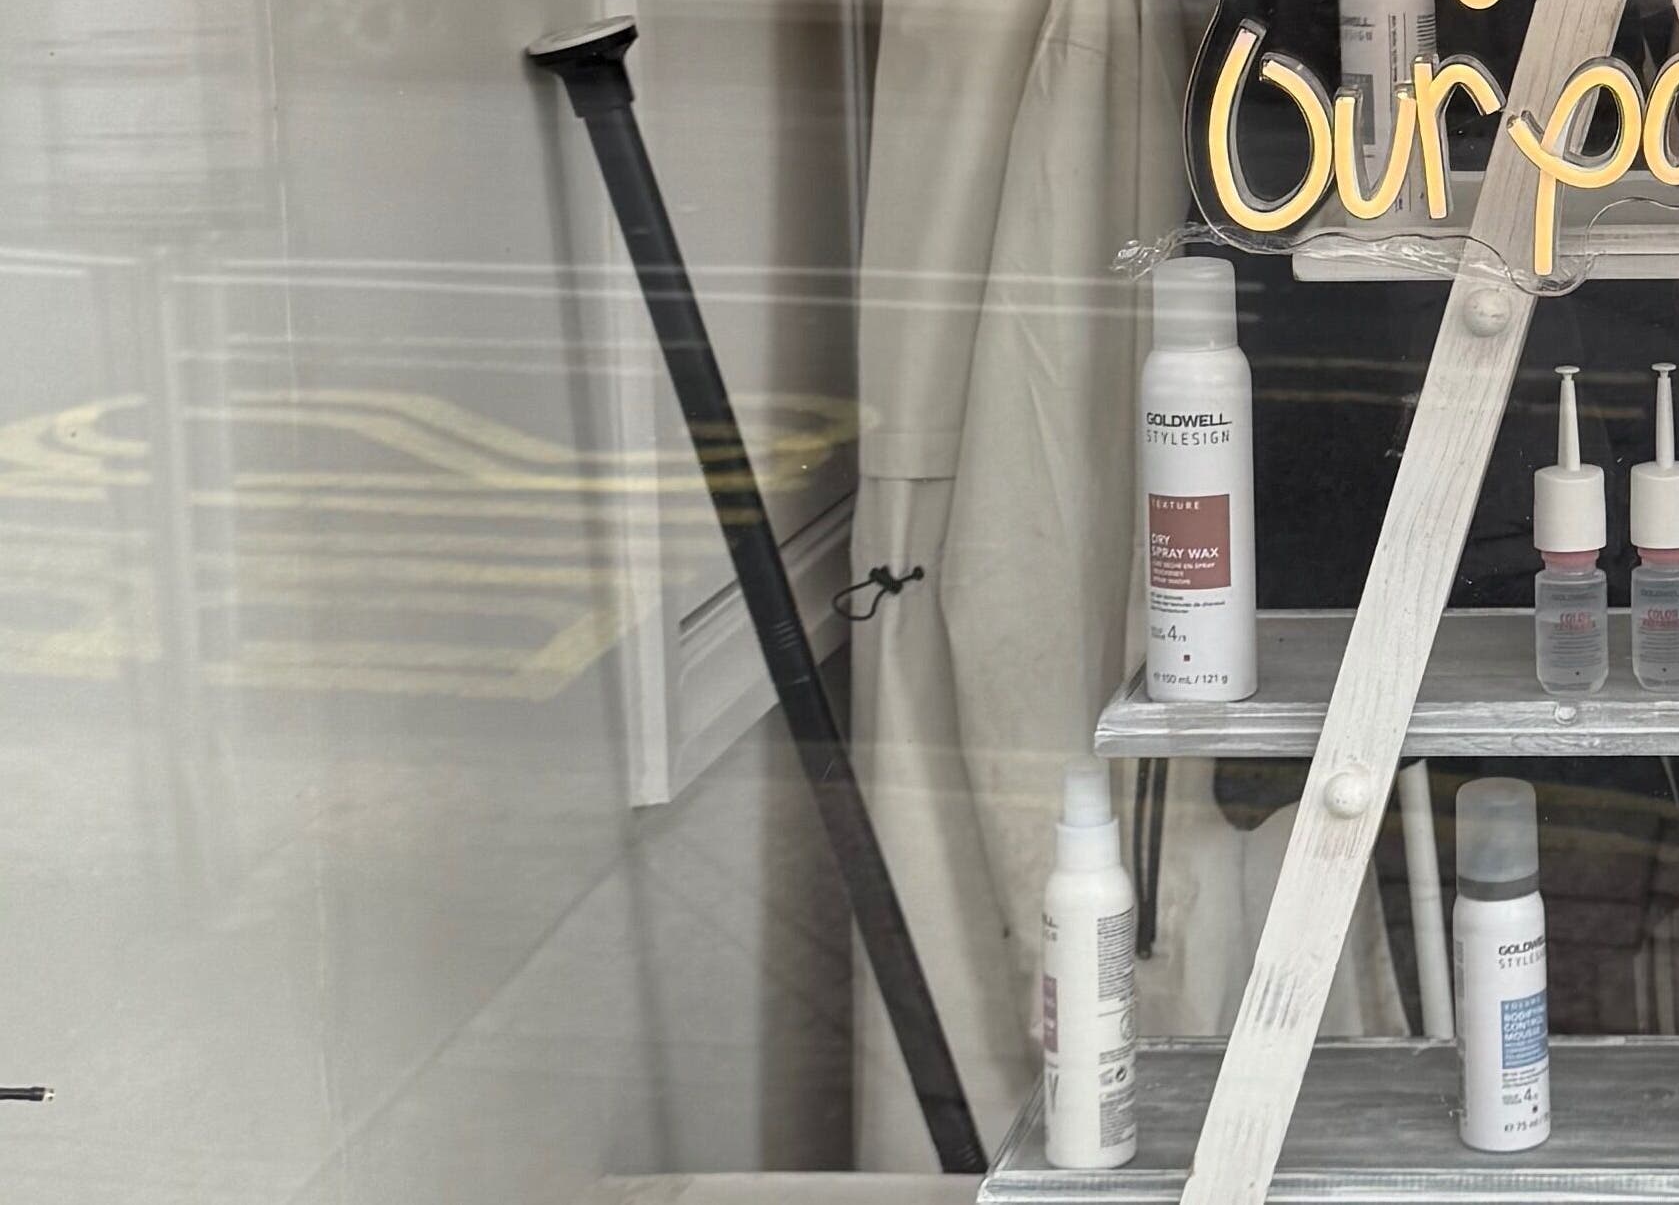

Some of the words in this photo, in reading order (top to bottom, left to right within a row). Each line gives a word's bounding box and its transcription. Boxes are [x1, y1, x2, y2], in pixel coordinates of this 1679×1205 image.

[1146, 412, 1232, 428] GOLDWELL
[1146, 429, 1230, 446] STYLESIGN
[1152, 499, 1200, 510] TEXTURE
[1151, 533, 1171, 546] DRY
[1151, 546, 1185, 559] SPRAY
[1187, 547, 1219, 559] WAX
[1503, 1015, 1543, 1032] CONTRO
